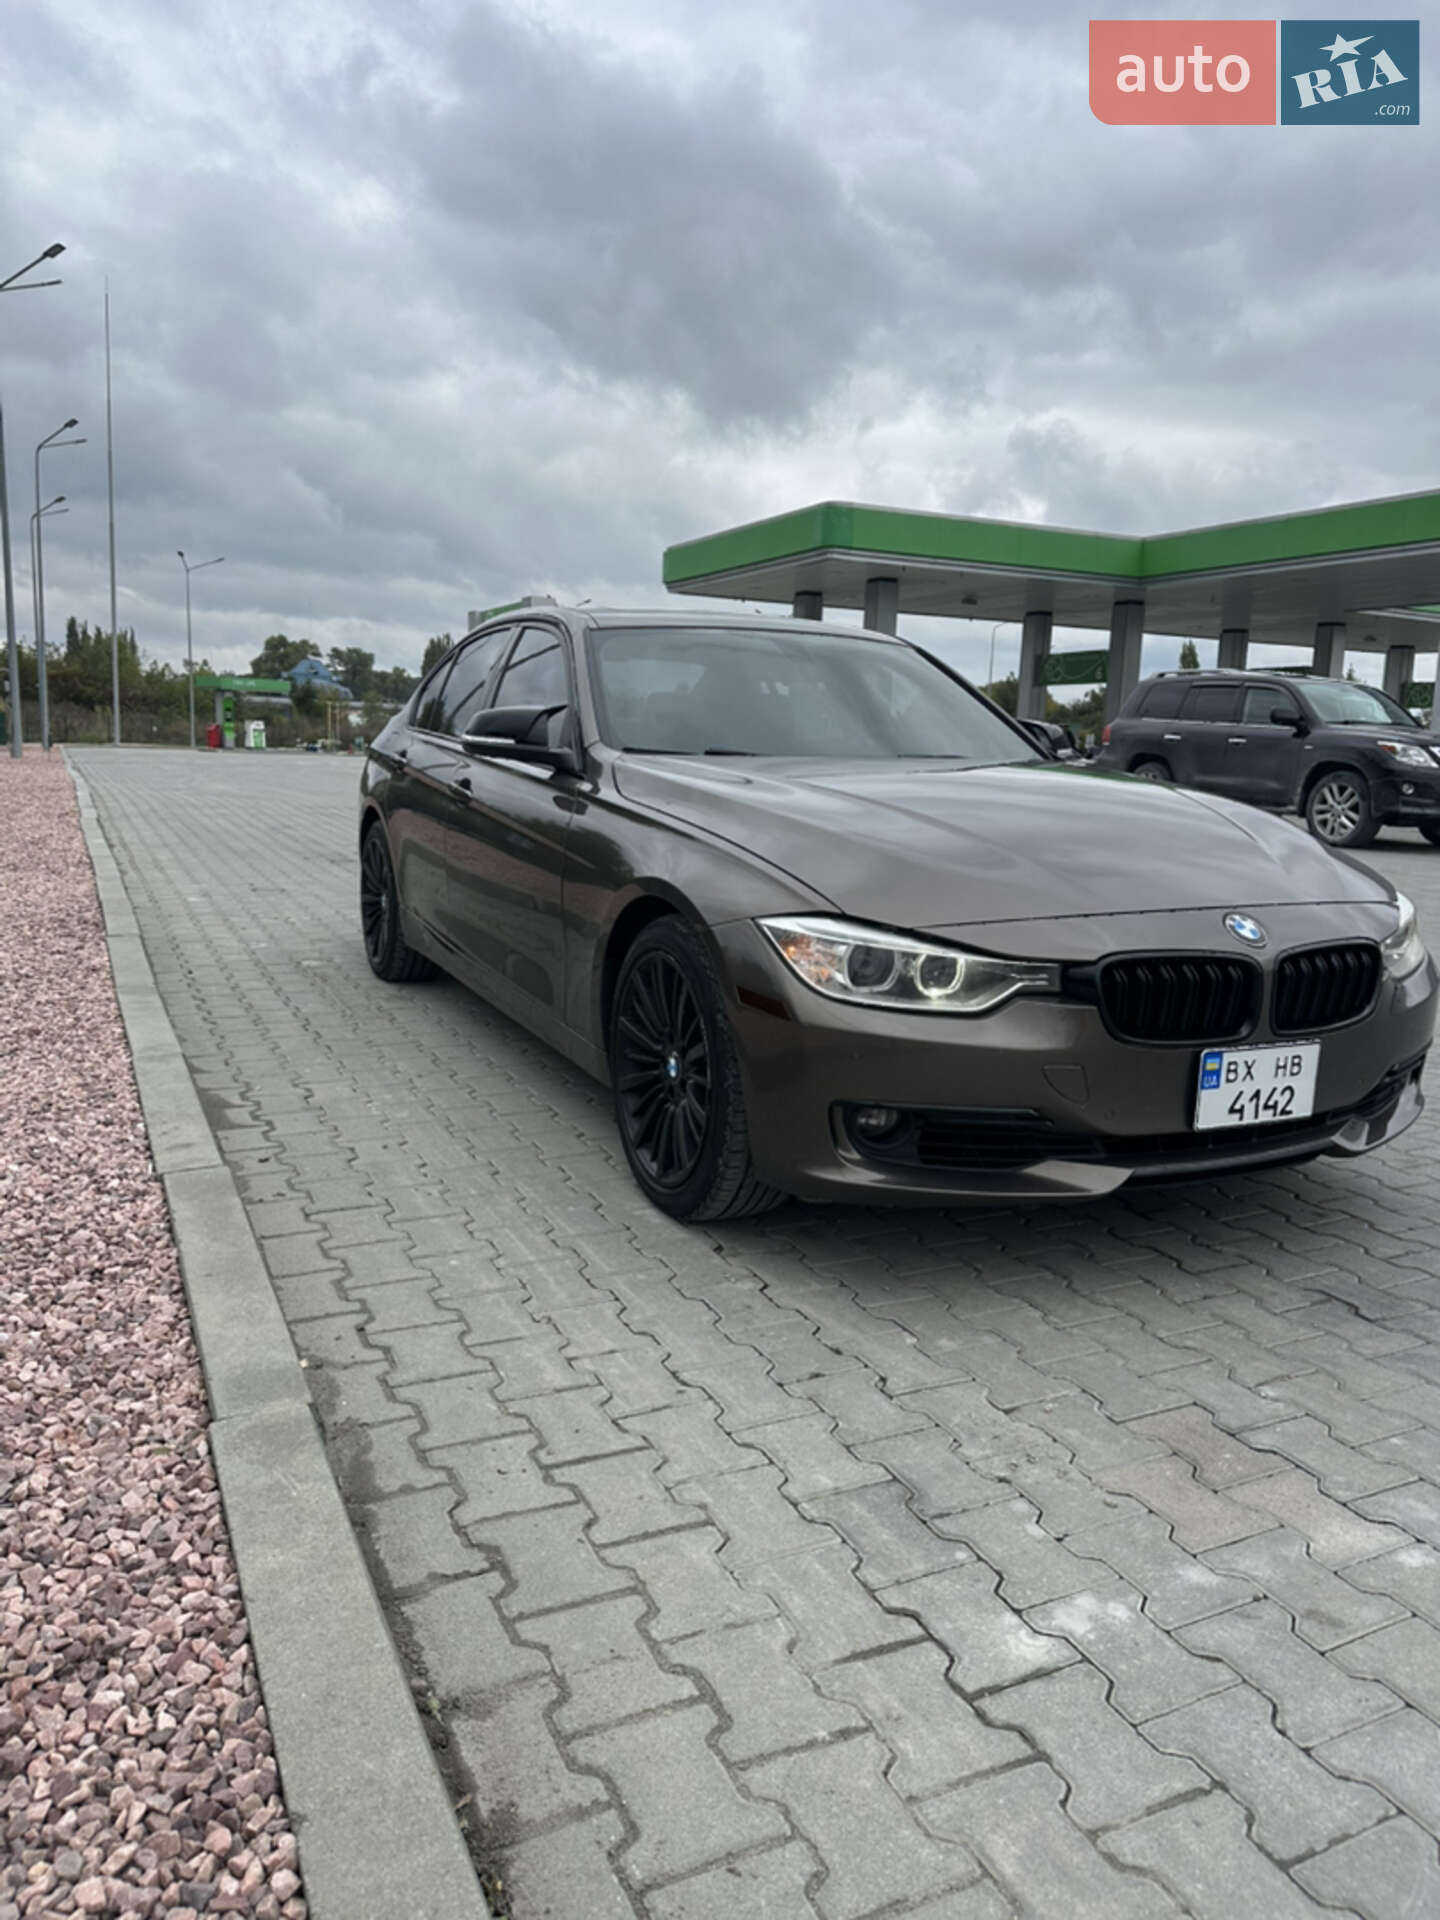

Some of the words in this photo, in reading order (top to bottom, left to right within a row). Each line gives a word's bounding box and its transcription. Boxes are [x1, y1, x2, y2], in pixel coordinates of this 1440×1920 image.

[1225, 1060, 1256, 1083] BX
[1274, 1055, 1302, 1079] HB
[1228, 1085, 1295, 1121] 4142
